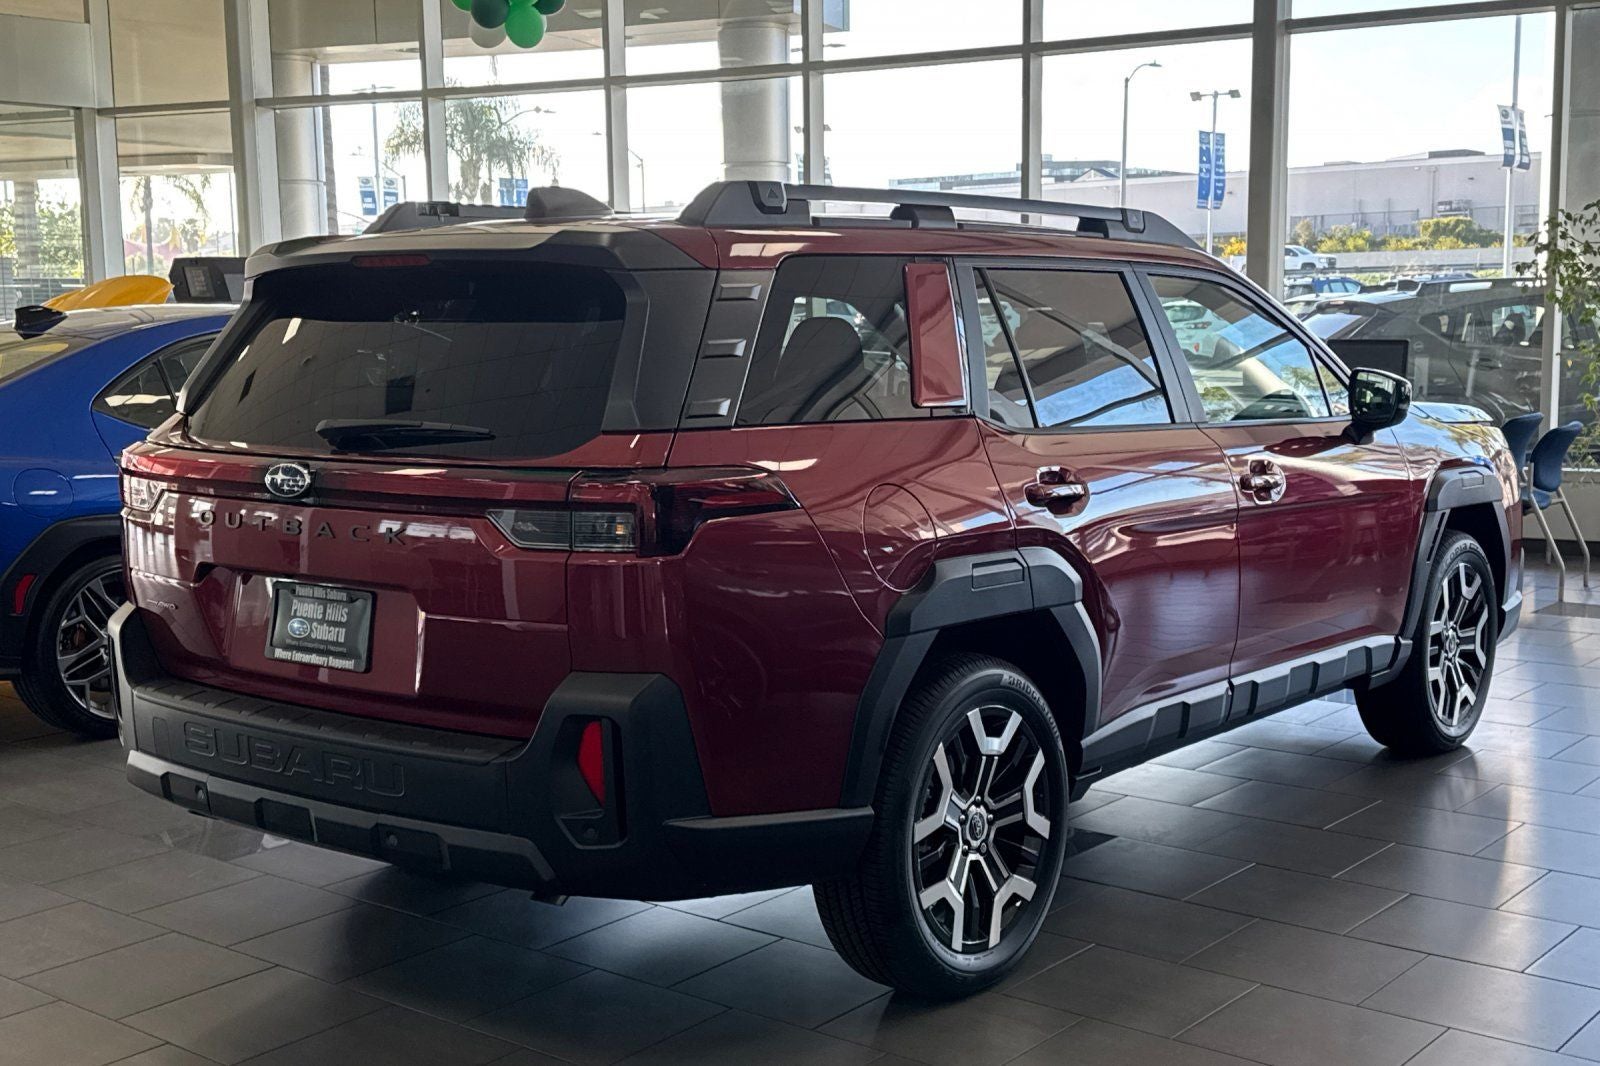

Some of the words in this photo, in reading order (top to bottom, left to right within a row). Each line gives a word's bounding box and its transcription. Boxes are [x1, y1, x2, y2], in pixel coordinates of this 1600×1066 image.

[199, 509, 407, 546] OUTBACK
[291, 599, 324, 620] Puente
[325, 603, 349, 623] Hills
[310, 622, 346, 643] Subaru
[274, 647, 292, 660] Where
[292, 650, 328, 667] Extraordinary
[183, 720, 405, 797] SUBARU
